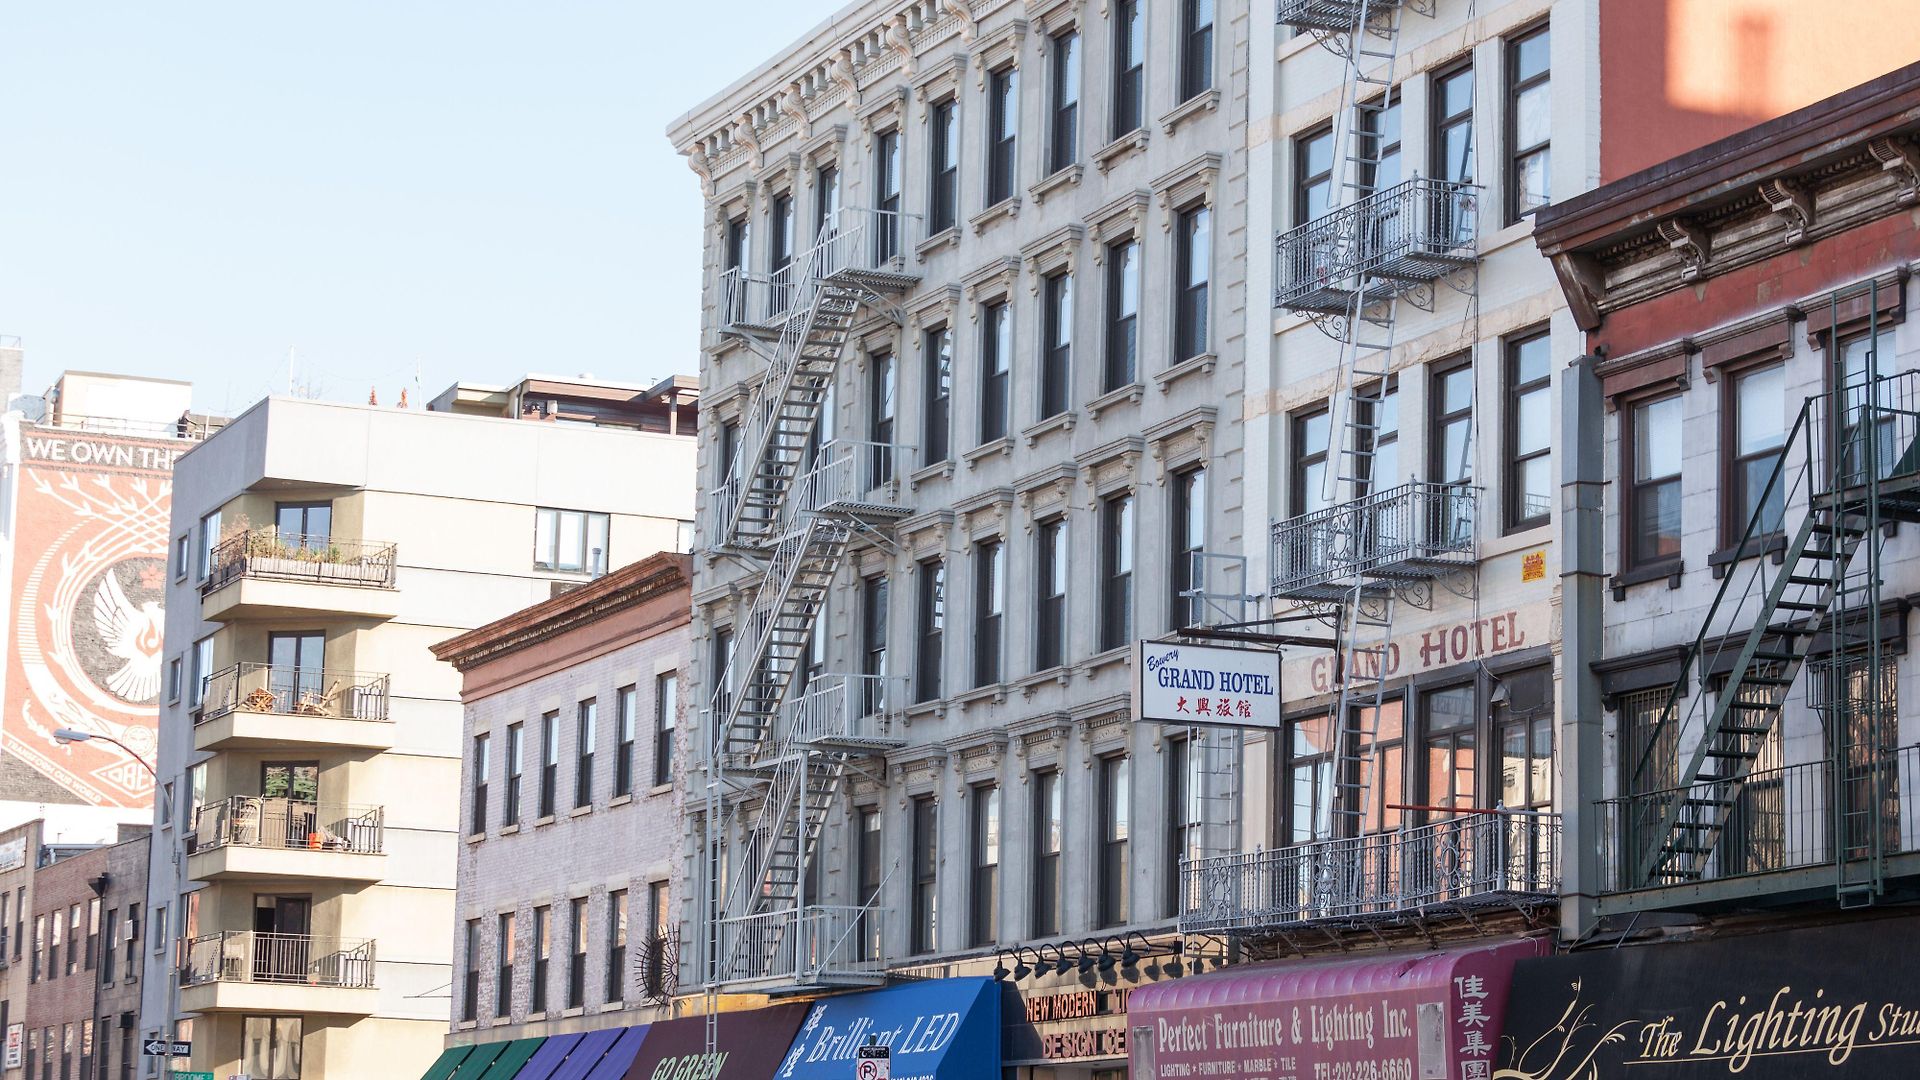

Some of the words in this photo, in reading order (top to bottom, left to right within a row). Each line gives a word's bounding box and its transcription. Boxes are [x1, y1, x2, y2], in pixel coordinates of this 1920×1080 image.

[27, 438, 66, 460] WE
[71, 442, 133, 467] OWN
[1419, 611, 1525, 668] HOTEL
[1147, 649, 1179, 671] Bowery
[1158, 667, 1214, 690] GRAND
[1219, 671, 1274, 695] HOTEL
[1176, 696, 1252, 718] 大興旅館
[7, 739, 55, 776] TRANSFORM
[54, 766, 74, 786] OUR
[72, 780, 103, 803] WORLD
[107, 762, 157, 790] OBE
[1026, 996, 1050, 1022] NEW
[1052, 989, 1098, 1020] MODERN
[806, 1017, 903, 1064] Brillint
[898, 1012, 960, 1055] LED
[1159, 1016, 1208, 1052] Perfect
[1214, 1013, 1283, 1050] Furniture
[1291, 1006, 1303, 1045] &
[1311, 1004, 1375, 1051] Lighting
[1382, 1000, 1412, 1039] Inc.
[1640, 1015, 1683, 1059] The
[1690, 986, 1868, 1073] Lighting
[1869, 1003, 1920, 1041] Stu
[151, 1043, 165, 1052] ONE
[1043, 1030, 1097, 1058] DESIGN
[1103, 1026, 1128, 1055] CE
[651, 1057, 677, 1080] GO
[673, 1051, 729, 1080] GREEN
[1160, 1063, 1191, 1077] LIGHTING
[1199, 1060, 1236, 1075] FURNITURE
[1243, 1057, 1272, 1072] MARBLE
[1280, 1056, 1297, 1071] TILE
